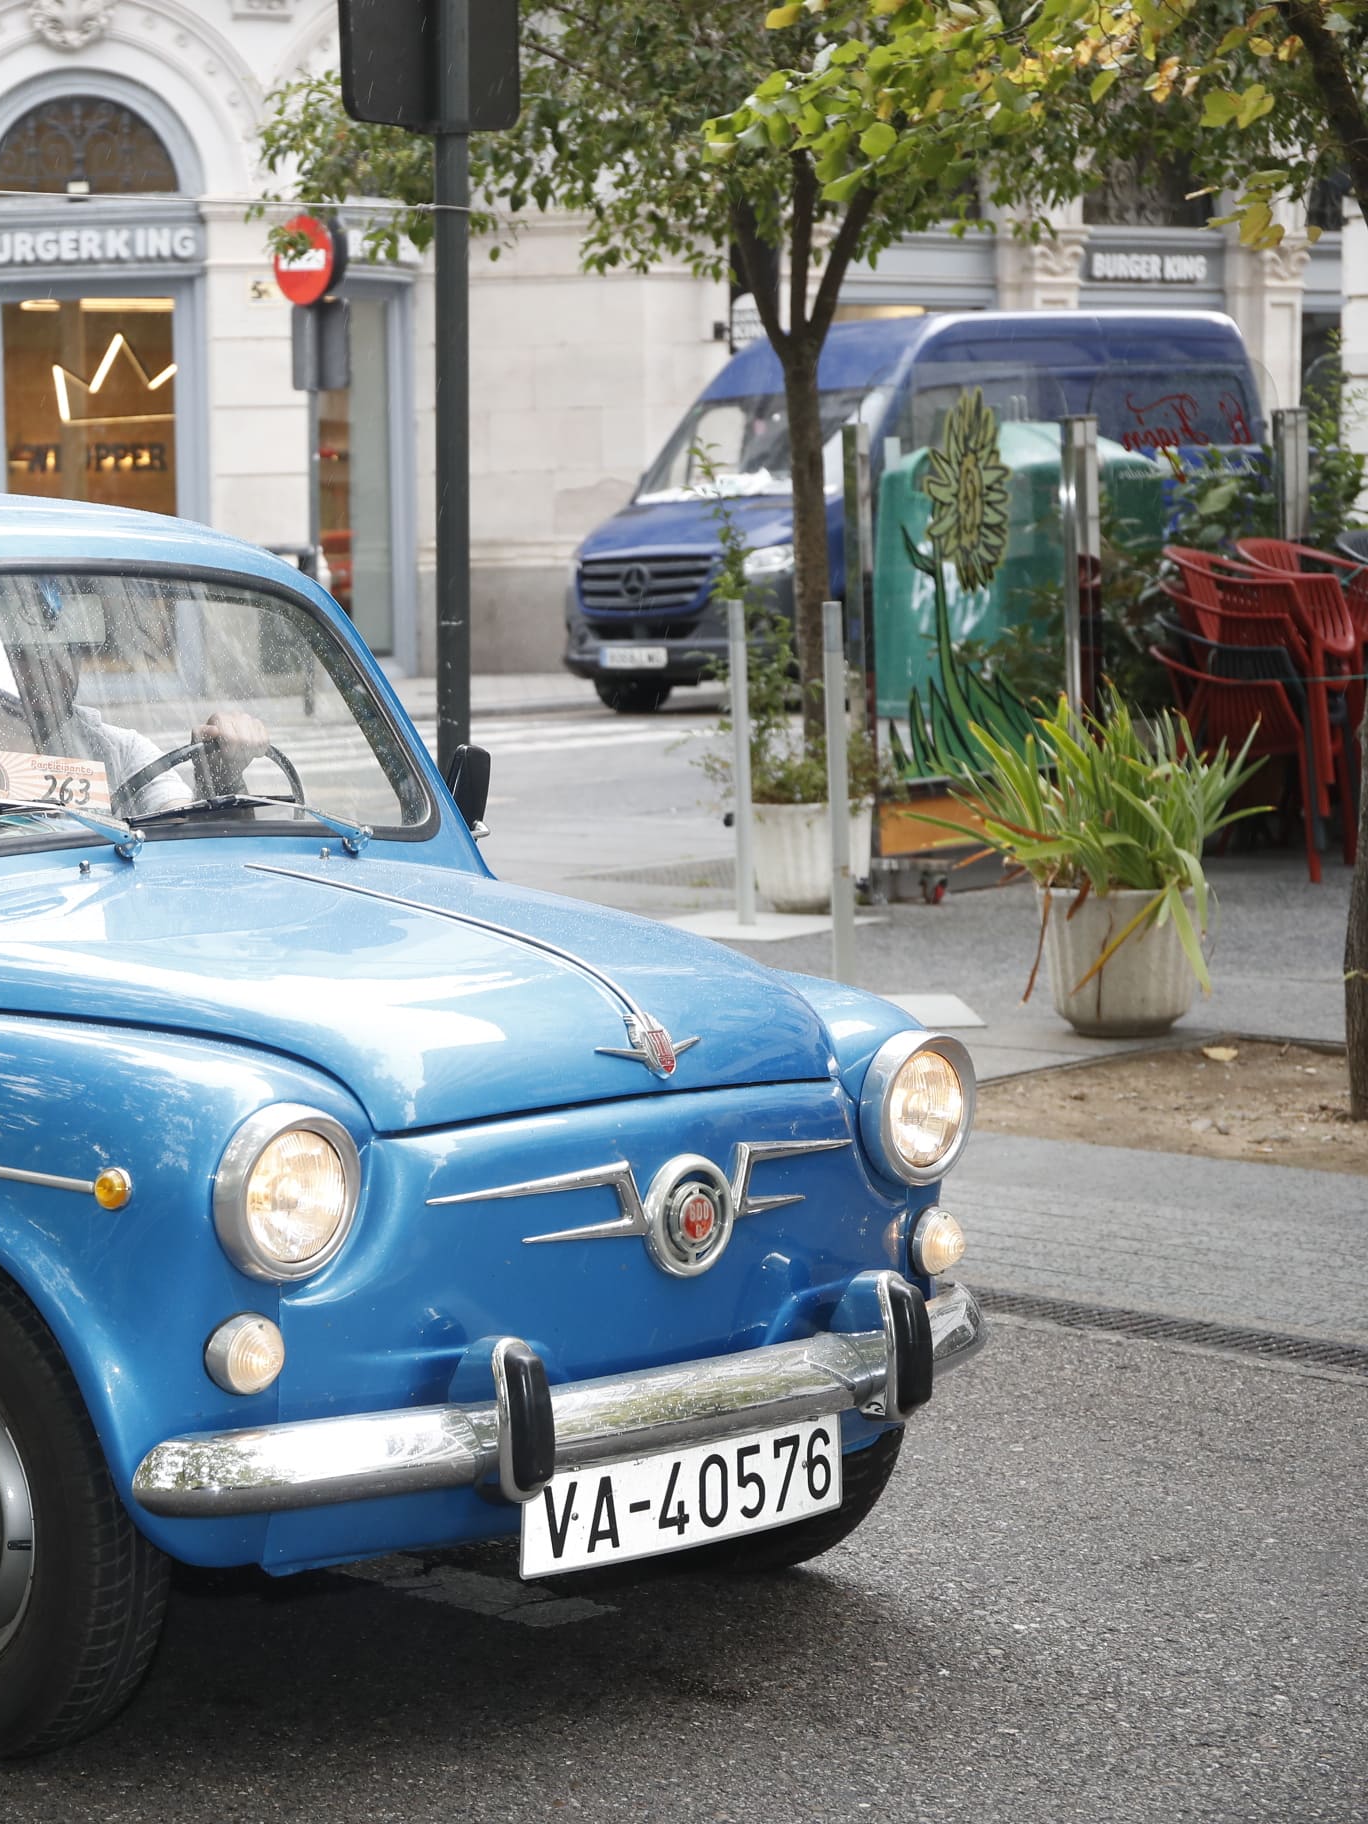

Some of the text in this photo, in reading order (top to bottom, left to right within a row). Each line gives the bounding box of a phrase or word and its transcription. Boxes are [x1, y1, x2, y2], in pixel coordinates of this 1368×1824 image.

[1092, 252, 1208, 281] BURGER KING
[41, 774, 91, 805] 263
[689, 1200, 709, 1222] 600
[543, 1427, 832, 1559] VA-40576
